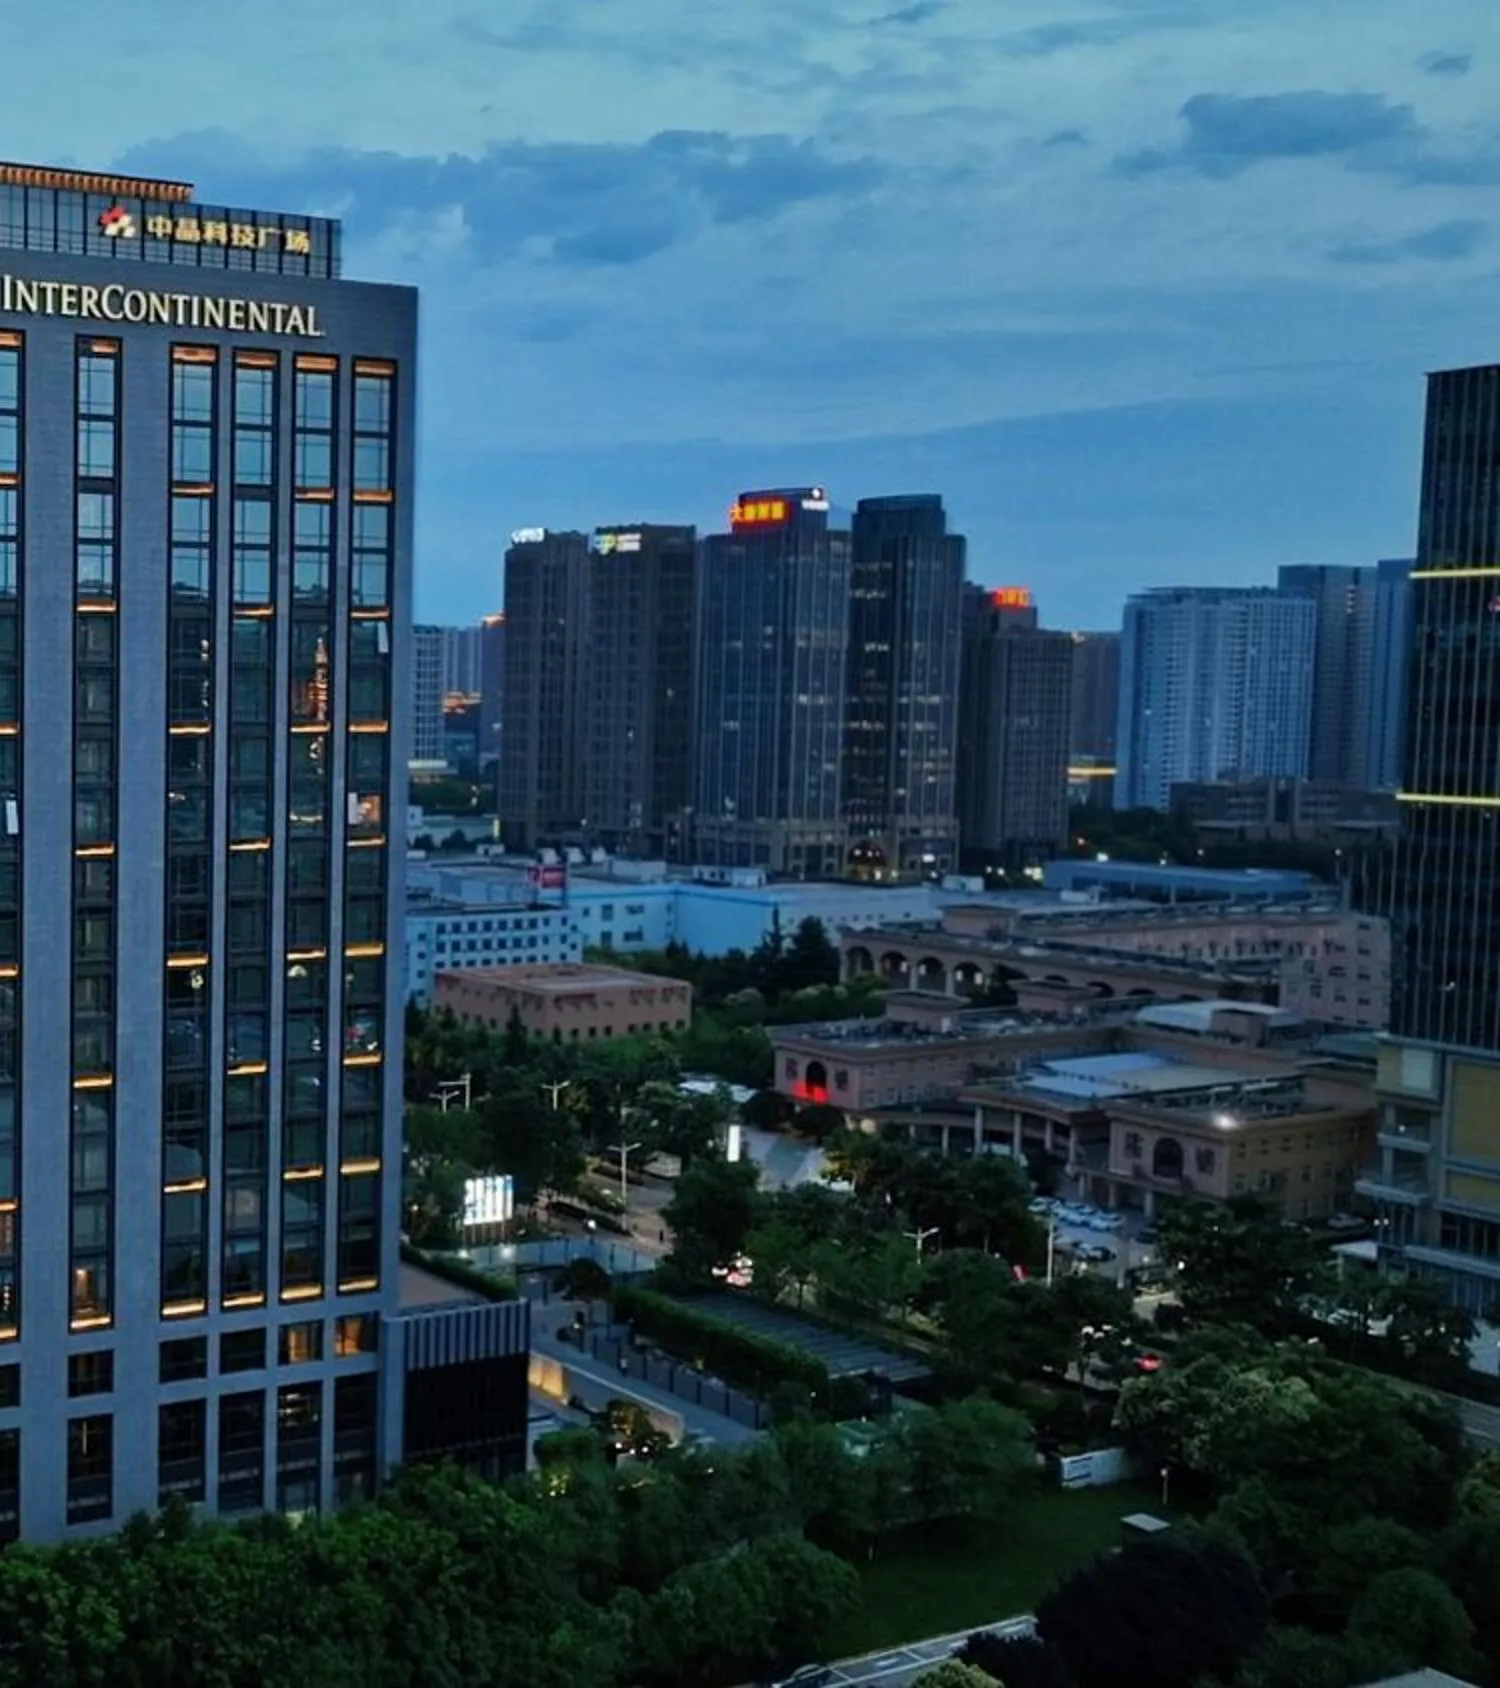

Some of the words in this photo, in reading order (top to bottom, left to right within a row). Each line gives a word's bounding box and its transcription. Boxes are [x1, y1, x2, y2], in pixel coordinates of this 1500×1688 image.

[147, 215, 310, 253] 中晶科技广场
